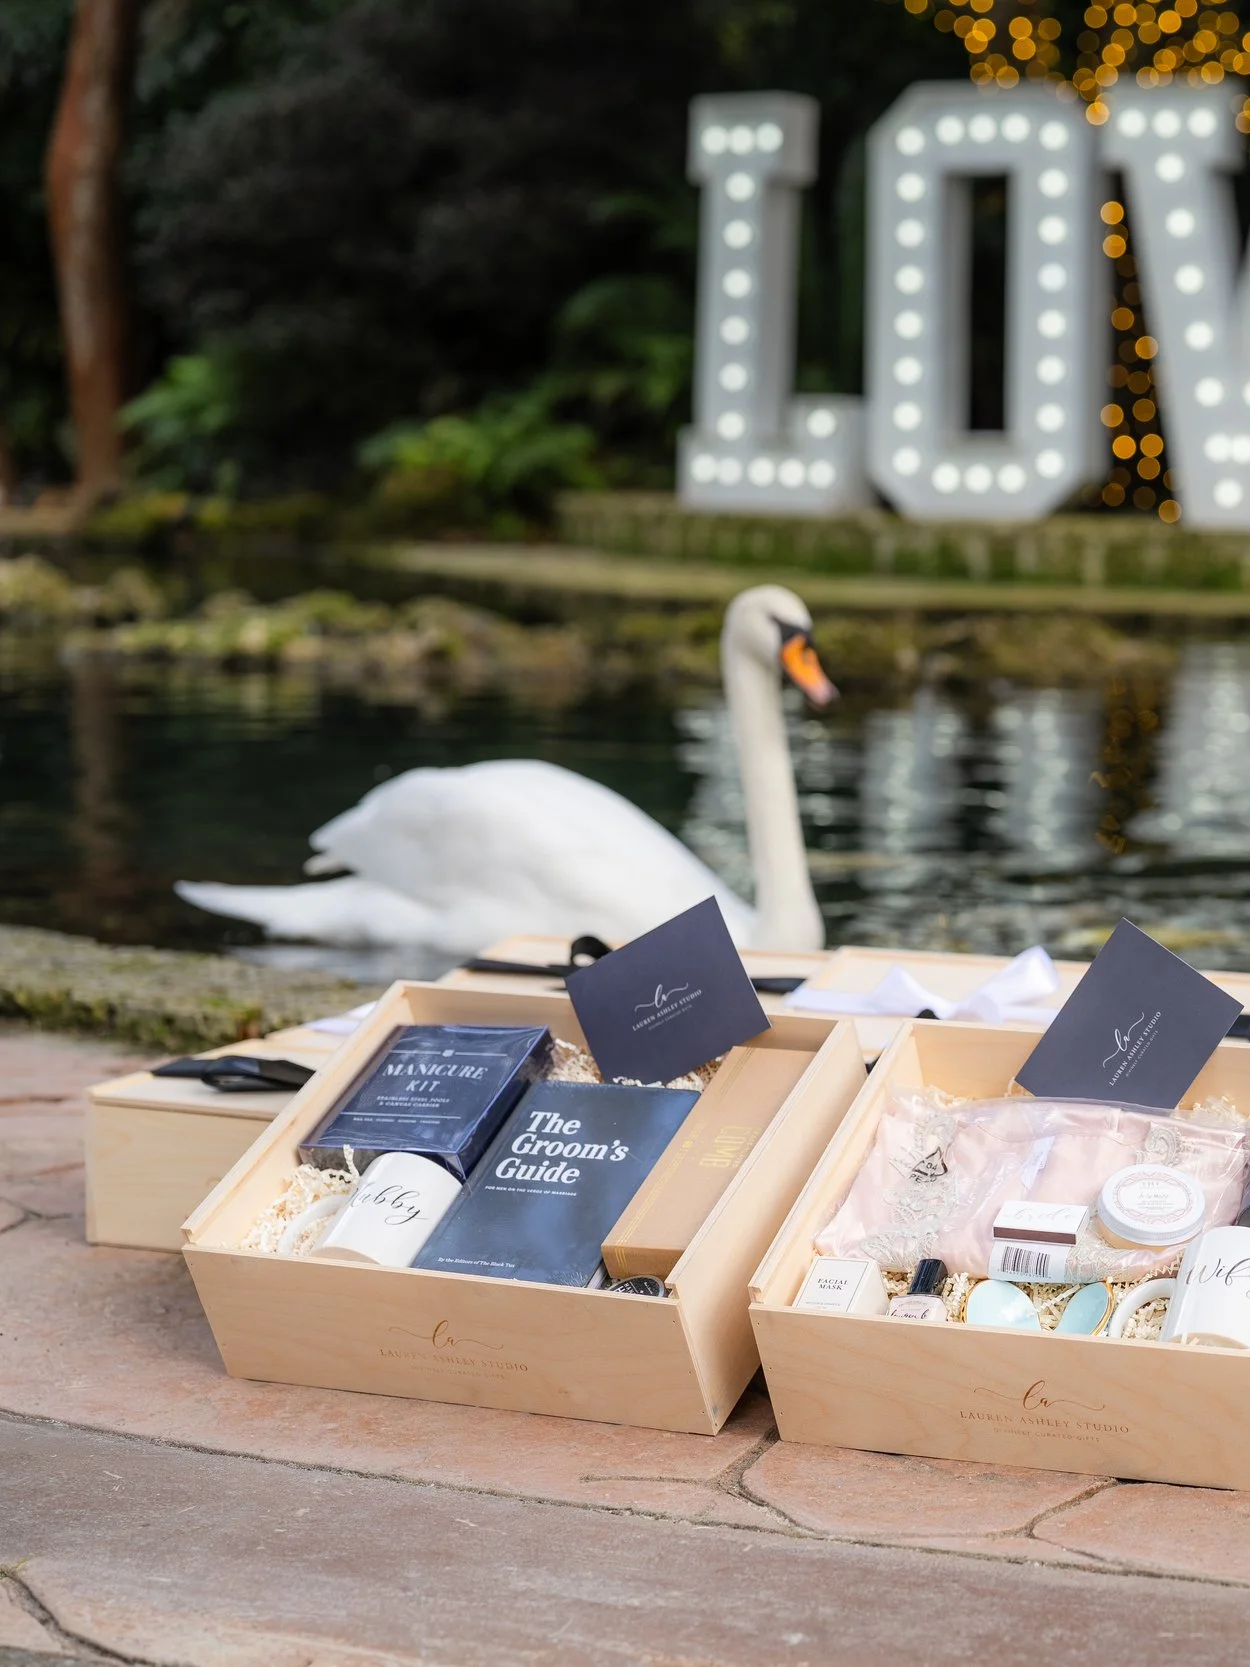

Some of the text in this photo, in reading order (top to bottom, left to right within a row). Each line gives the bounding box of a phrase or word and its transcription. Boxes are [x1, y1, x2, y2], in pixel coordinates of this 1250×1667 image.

[632, 1015, 656, 1031] LAUREN
[656, 1002, 679, 1018] ASHLEY
[679, 988, 702, 1005] STUDIO
[1109, 1011, 1162, 1086] LAUREN ASHLEY STUDIO
[382, 1063, 488, 1080] MANICURE
[405, 1079, 440, 1092] KIT
[526, 1111, 581, 1135] The
[495, 1157, 580, 1184] Guide
[926, 1162, 938, 1171] 04
[817, 1278, 849, 1286] FACIAL
[818, 1283, 844, 1291] MASK
[380, 1349, 528, 1372] LAUREN ASHLEY STUDIO
[959, 1410, 1129, 1434] LAUREN ASHLEY STUDIO
